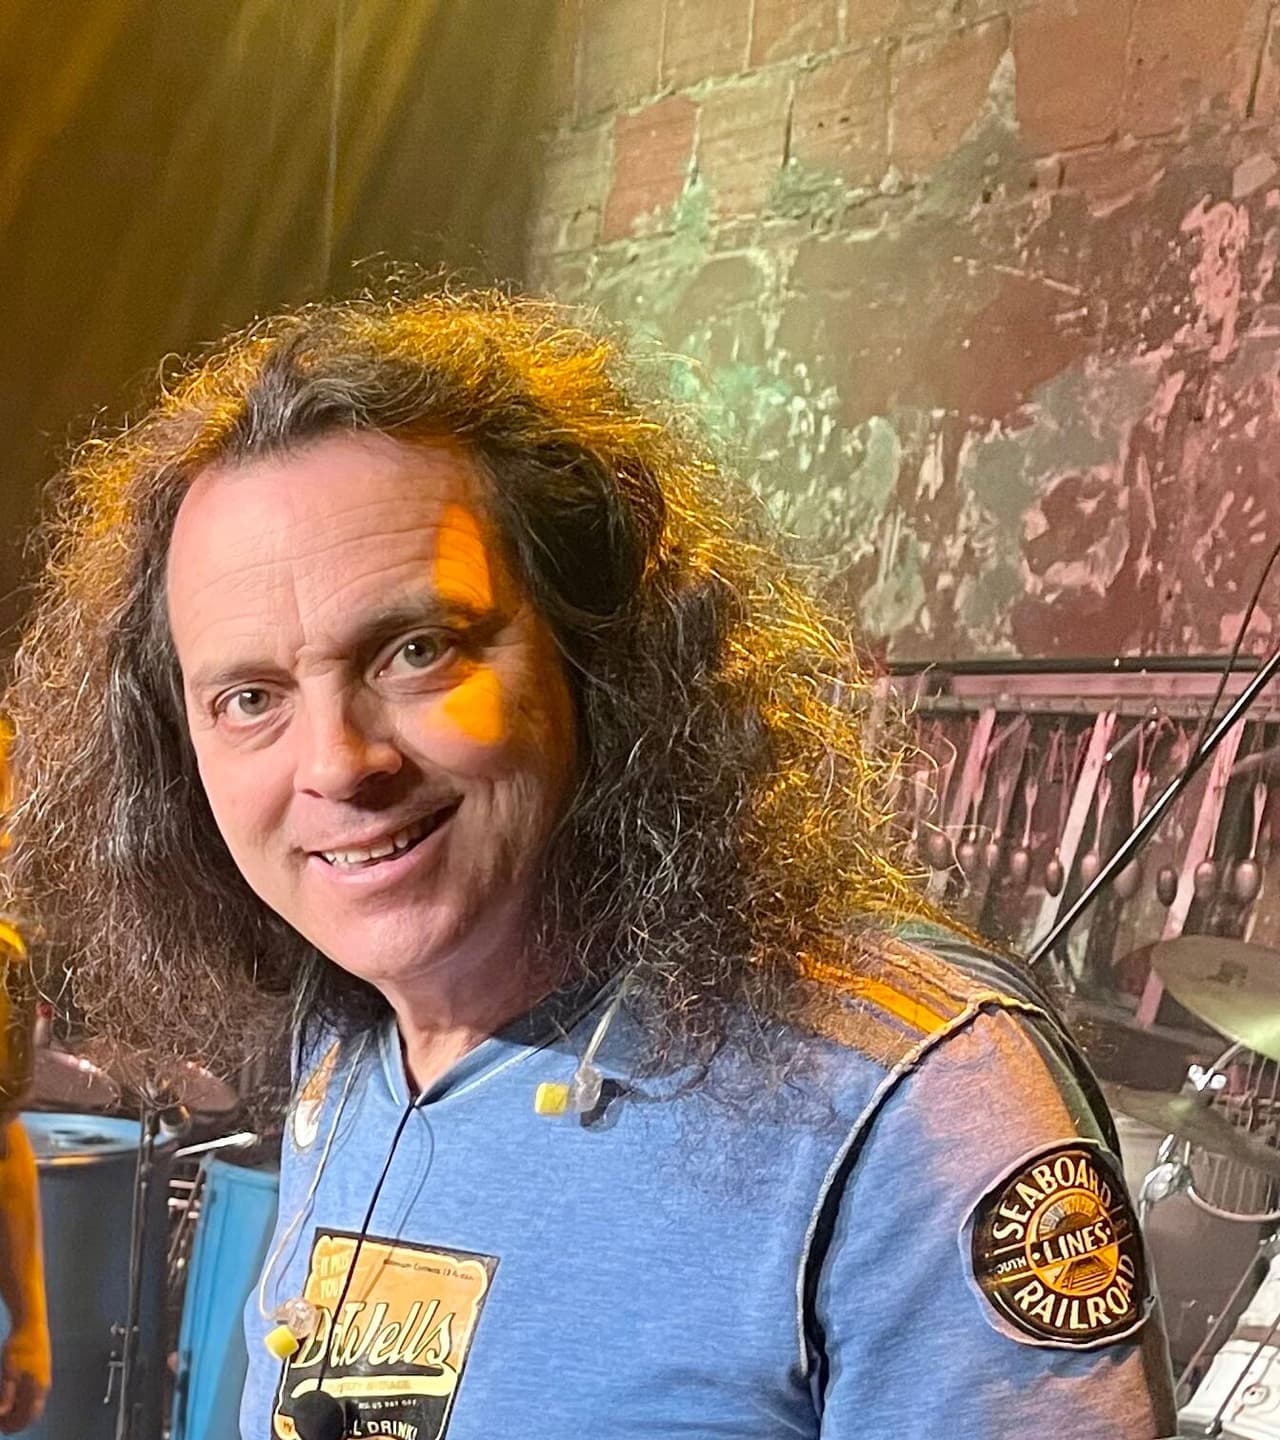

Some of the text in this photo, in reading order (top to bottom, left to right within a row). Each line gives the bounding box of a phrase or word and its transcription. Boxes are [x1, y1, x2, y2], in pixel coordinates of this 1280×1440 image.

[993, 1156, 1113, 1241] SEABOARD
[1042, 1221, 1106, 1264] LINES
[1014, 1253, 1136, 1330] RAILROAD
